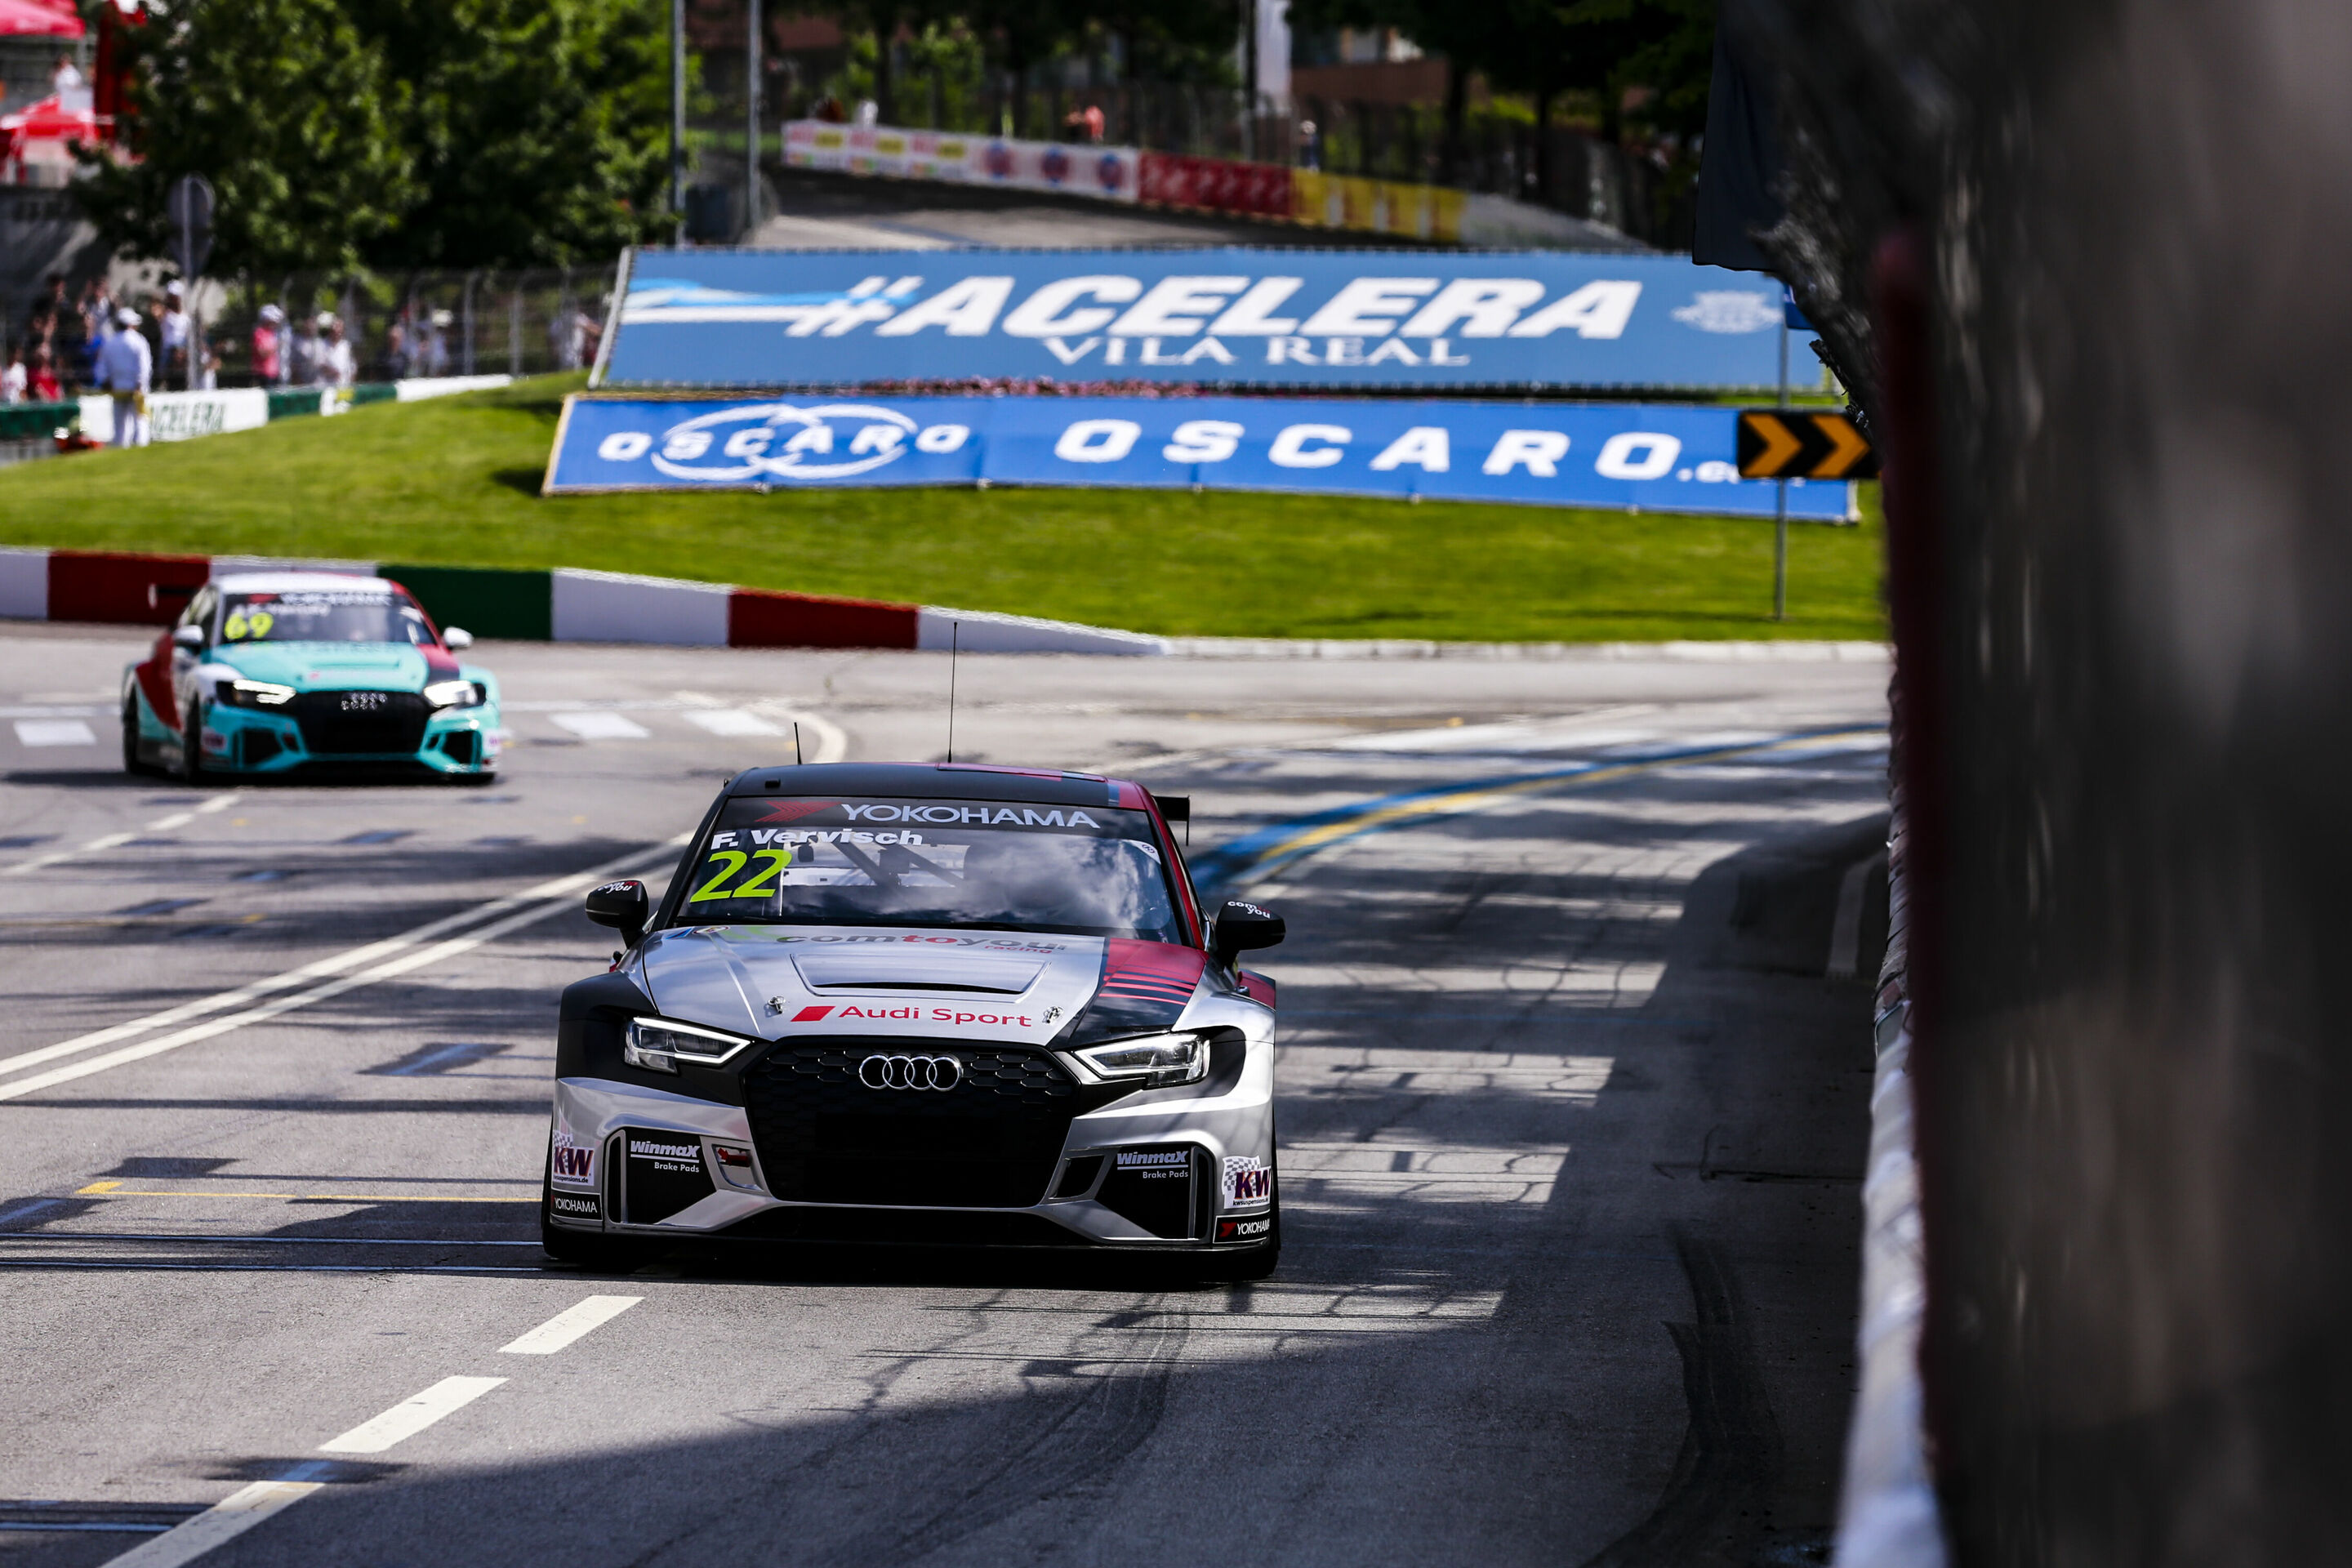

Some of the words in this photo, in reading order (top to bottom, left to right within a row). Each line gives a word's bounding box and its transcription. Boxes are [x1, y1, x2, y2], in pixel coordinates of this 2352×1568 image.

[1043, 336, 1238, 366] VILA
[1266, 336, 1471, 367] REAL
[597, 423, 971, 461] OSCARO
[225, 612, 274, 639] 69
[841, 804, 1101, 828] YOKOHAMA
[710, 831, 739, 849] F.
[751, 828, 924, 846] Vervisch
[689, 849, 792, 903] 22
[1247, 906, 1271, 920] you
[984, 945, 1053, 954] racing
[838, 1005, 920, 1019] Audi
[931, 1008, 1032, 1027] Sport
[554, 1146, 595, 1177] KW
[654, 1161, 678, 1170] Brake
[680, 1164, 700, 1172] Pads
[1143, 1170, 1167, 1178] Brake
[1169, 1169, 1188, 1178] Pads
[1234, 1169, 1271, 1200] KW
[555, 1196, 598, 1214] YOKOHAMA
